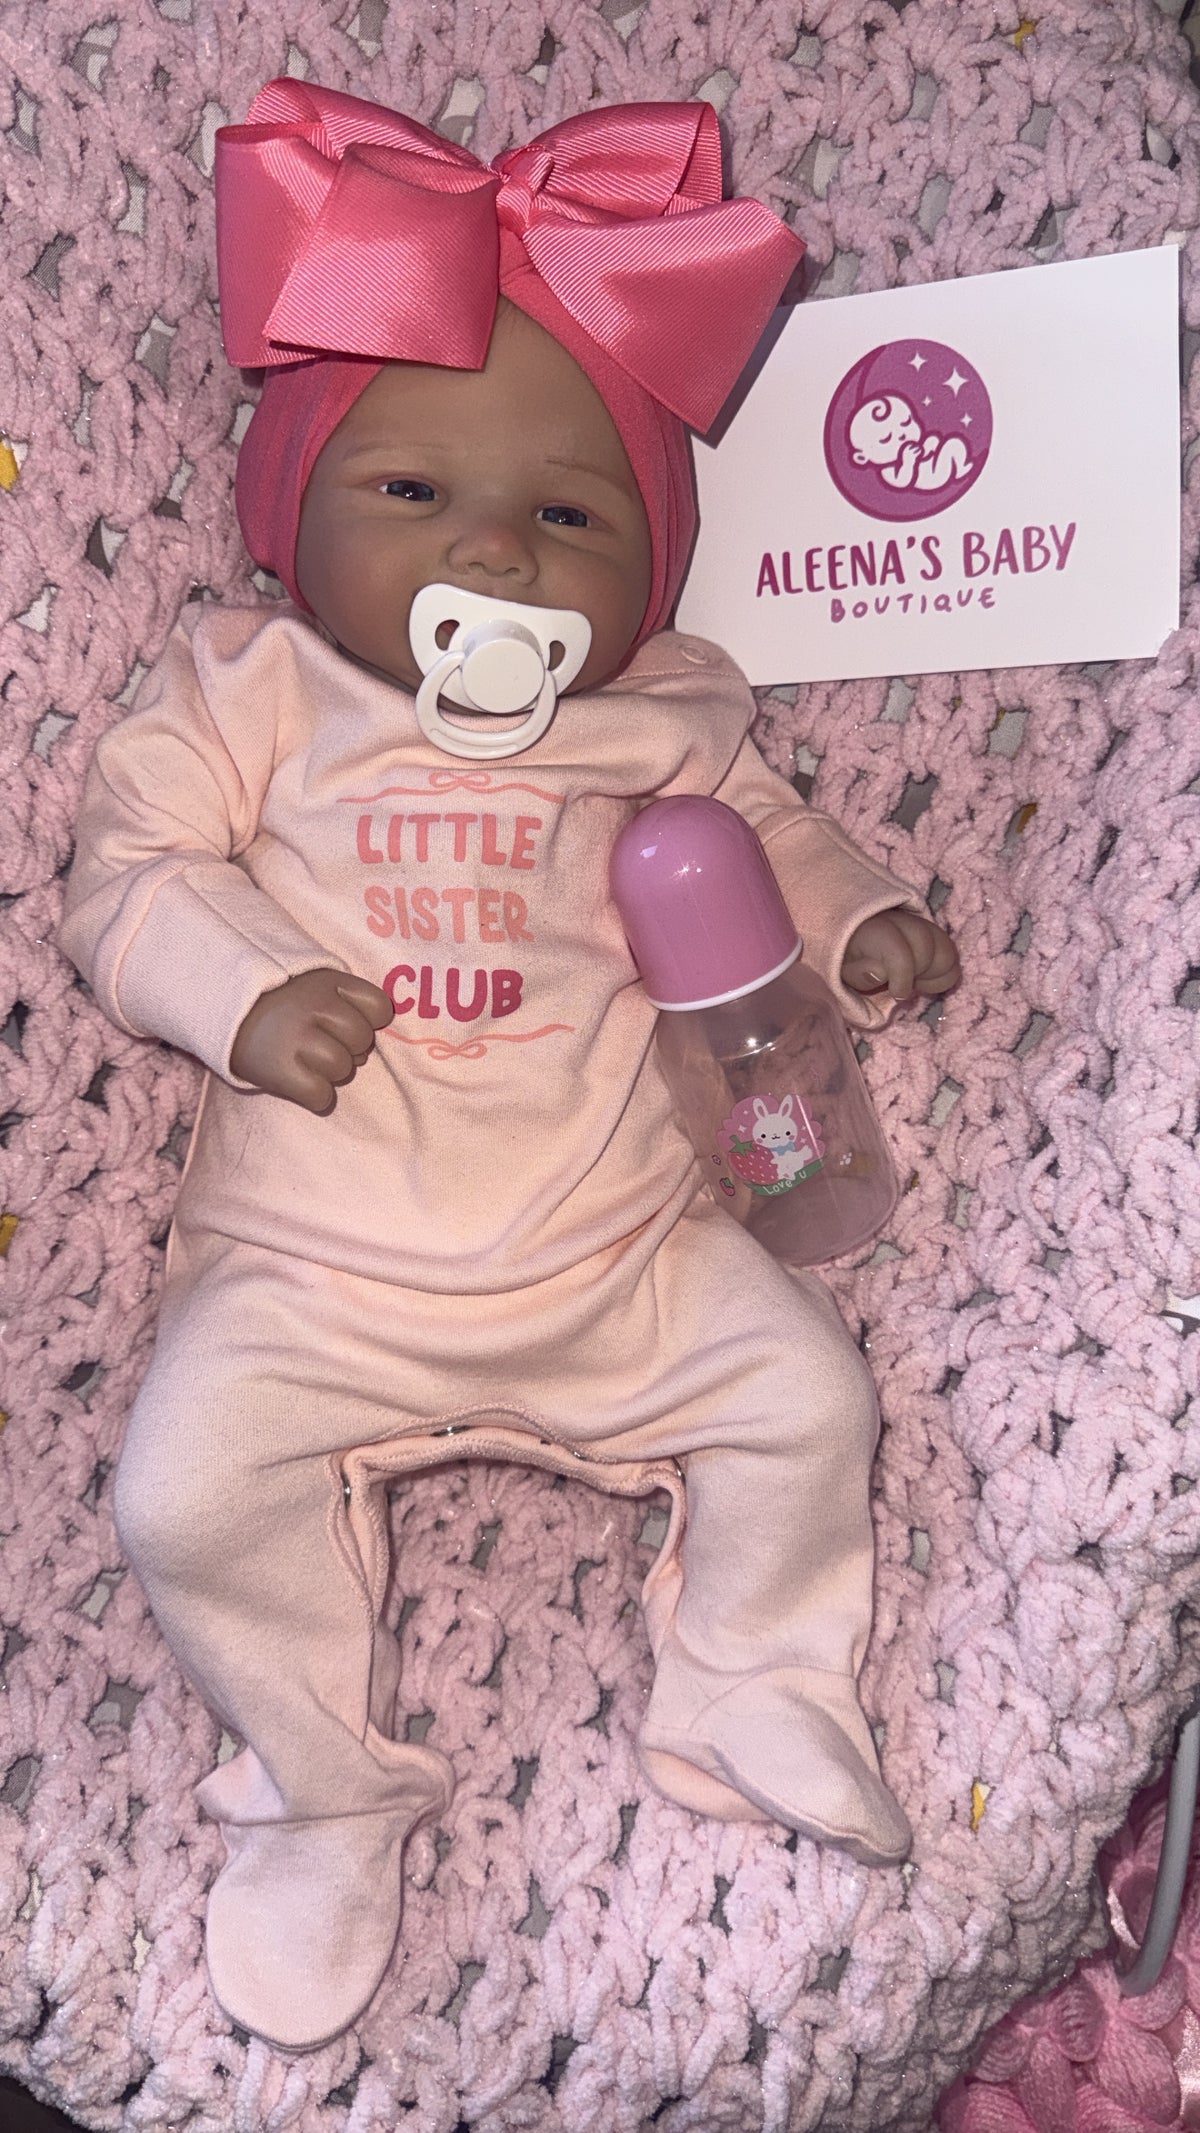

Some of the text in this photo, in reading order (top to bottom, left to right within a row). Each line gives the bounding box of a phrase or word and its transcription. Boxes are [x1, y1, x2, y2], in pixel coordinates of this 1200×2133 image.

[756, 522, 1077, 598] ALEENA'S BABY
[830, 587, 997, 624] BOUTIQUE
[356, 813, 543, 870] LITTLE
[364, 886, 535, 944] SISTER
[382, 964, 524, 1022] CLUB
[763, 1179, 793, 1195] Love
